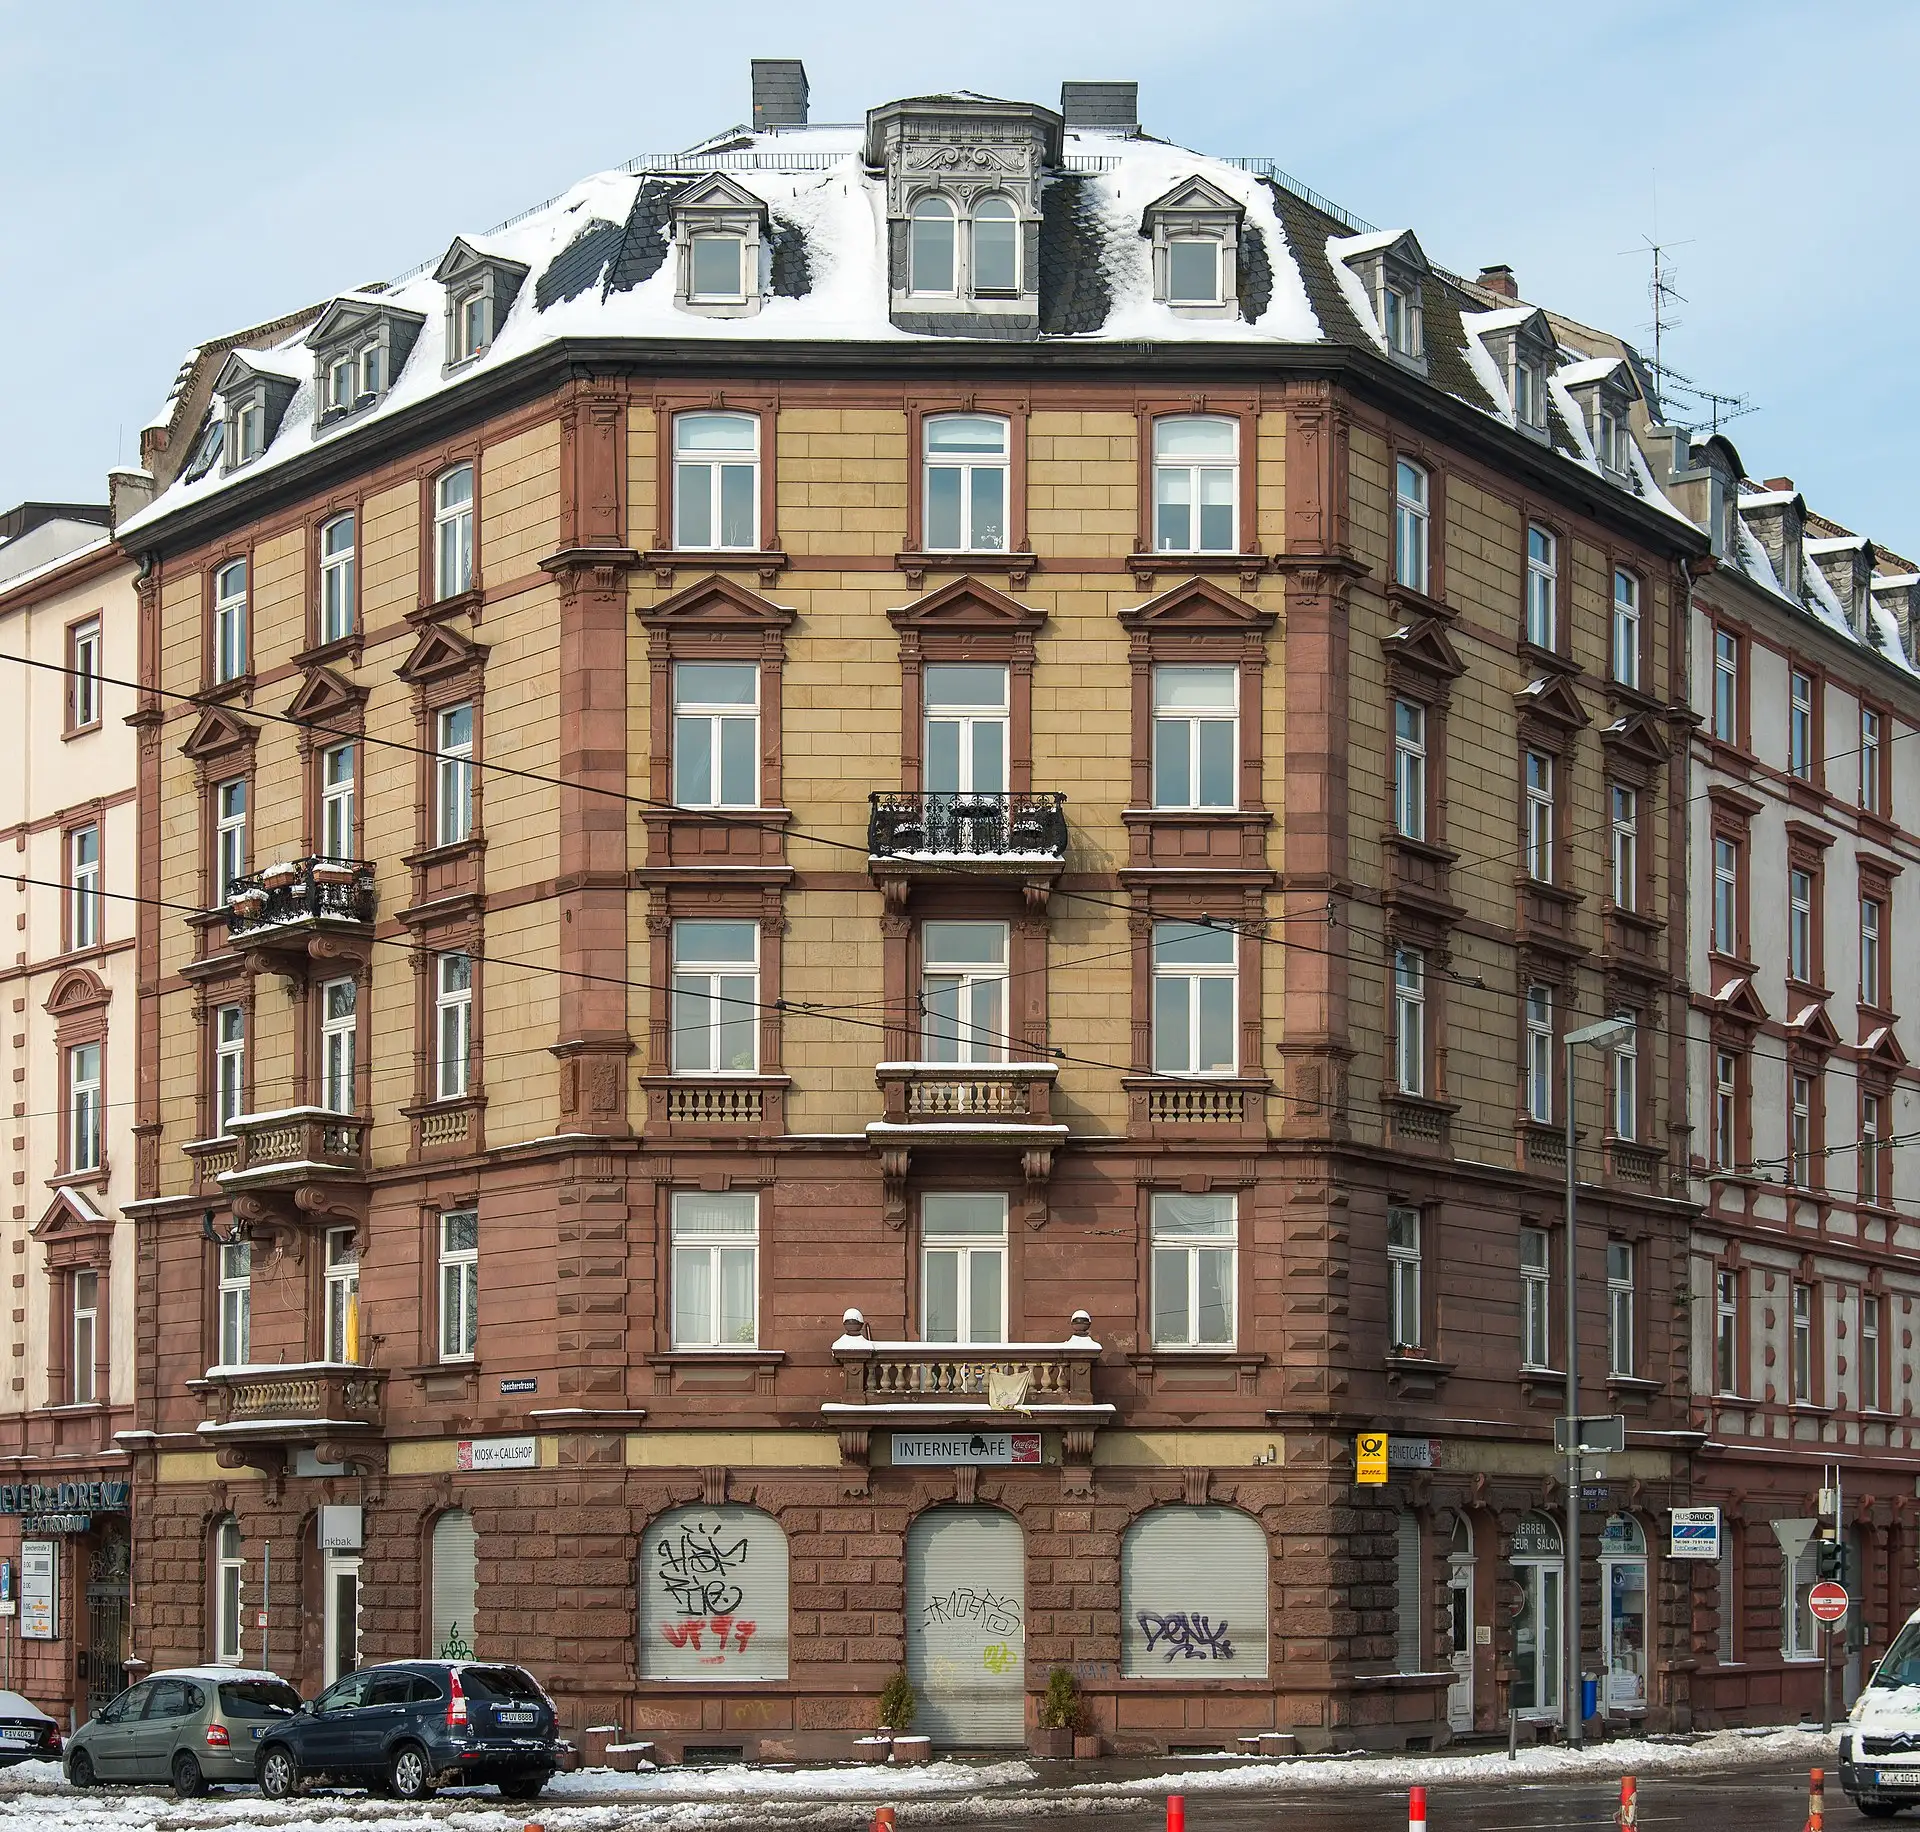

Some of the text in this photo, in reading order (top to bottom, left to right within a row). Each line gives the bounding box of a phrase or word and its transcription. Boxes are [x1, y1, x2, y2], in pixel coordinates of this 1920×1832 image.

[501, 1383, 534, 1391] Speicherstrasse
[0, 1484, 41, 1508] EYER
[57, 1482, 124, 1507] LORENZ
[1675, 1512, 1714, 1521] AUSDRUCK
[325, 1538, 352, 1546] nkbak
[1536, 1538, 1560, 1550] SALON
